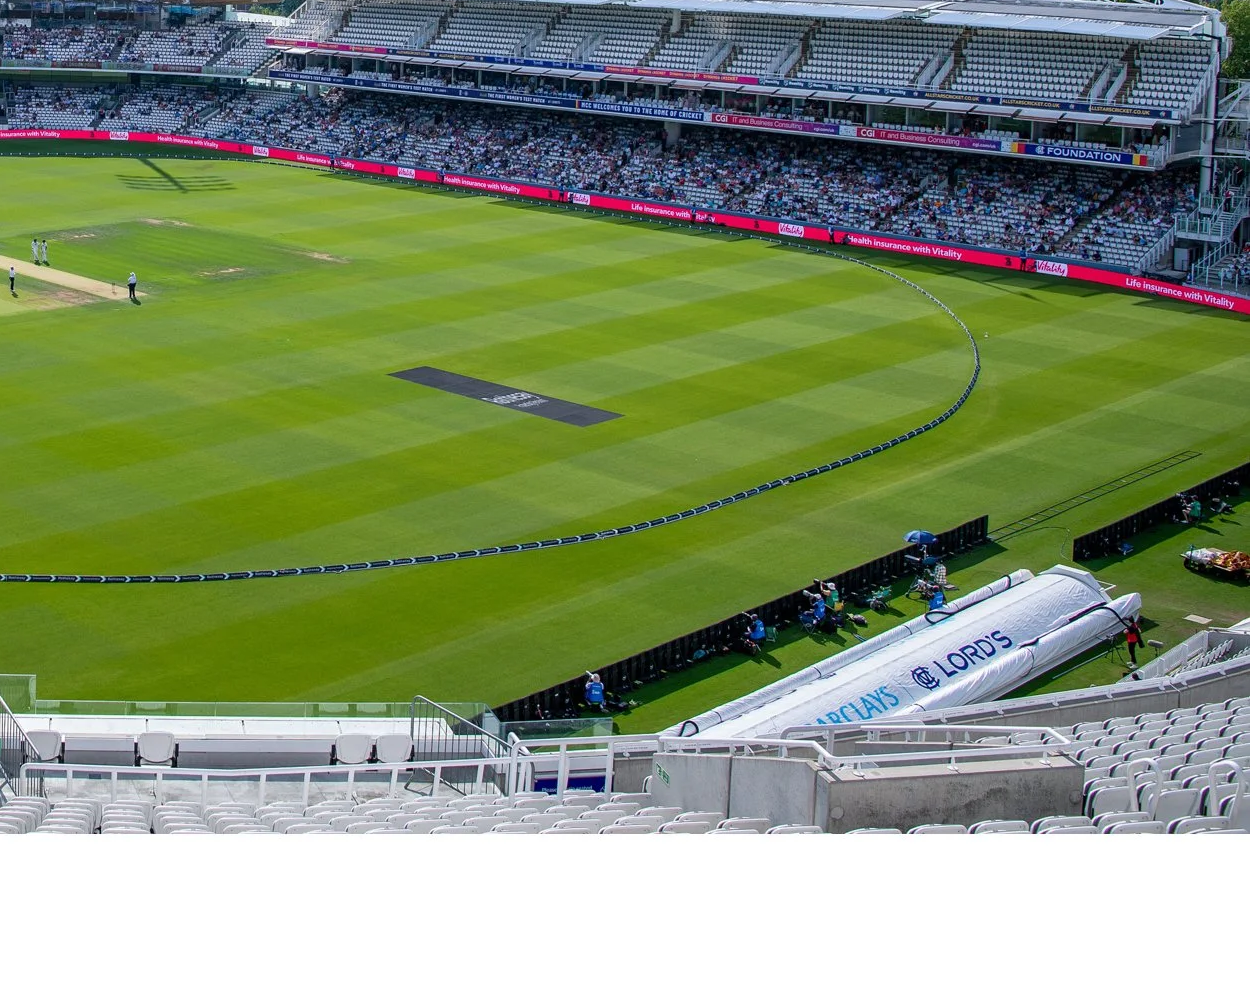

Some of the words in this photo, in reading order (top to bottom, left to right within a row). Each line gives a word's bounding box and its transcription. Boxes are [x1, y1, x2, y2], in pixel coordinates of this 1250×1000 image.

[593, 103, 621, 112] WELCOMES
[653, 108, 669, 116] HOME
[678, 111, 703, 119] CRICKET
[715, 114, 728, 123] CGI
[750, 118, 774, 127] Business
[774, 120, 803, 131] Consulting
[157, 135, 172, 143] Health
[204, 140, 219, 149] Vitality
[860, 129, 875, 138] CGI
[900, 133, 926, 143] Business
[928, 136, 960, 146] Consulting
[1047, 147, 1121, 162] FOUNDATION
[444, 175, 461, 185] Health
[461, 177, 487, 188] insurance
[487, 181, 500, 190] with
[500, 183, 521, 194] Vitality
[631, 203, 643, 212] Life
[644, 205, 675, 217] insurance
[675, 209, 690, 219] with
[779, 222, 803, 237] Vitality
[847, 234, 873, 246] Health
[873, 239, 911, 252] insurance
[912, 244, 931, 255] with
[932, 247, 962, 260] Vitality
[1037, 260, 1066, 275] Vitality
[1125, 277, 1141, 289] Life
[1143, 281, 1183, 297] insurance
[1183, 290, 1203, 302] with
[1203, 293, 1235, 310] Vitality
[933, 630, 1013, 677] LORD'S
